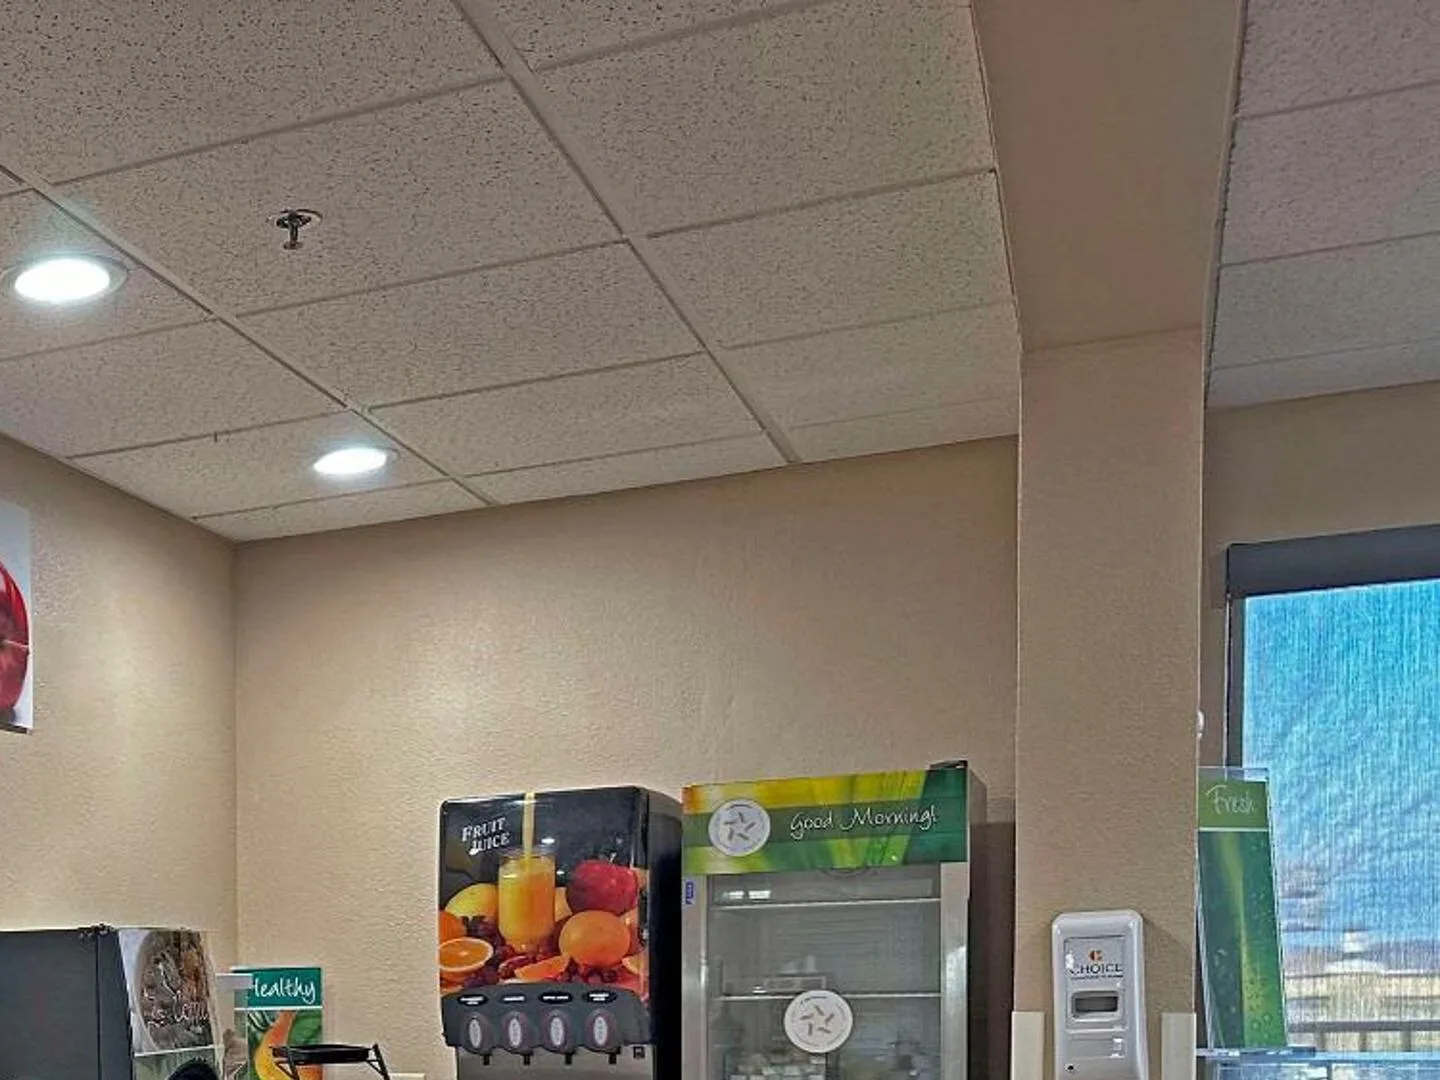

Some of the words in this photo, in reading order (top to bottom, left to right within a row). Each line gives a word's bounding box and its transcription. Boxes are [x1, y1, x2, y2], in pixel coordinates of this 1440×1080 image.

[1205, 785, 1255, 816] Fresh
[462, 816, 506, 842] FRUIT
[789, 811, 835, 840] Good
[839, 804, 938, 831] Morning!
[468, 832, 510, 855] JUICE
